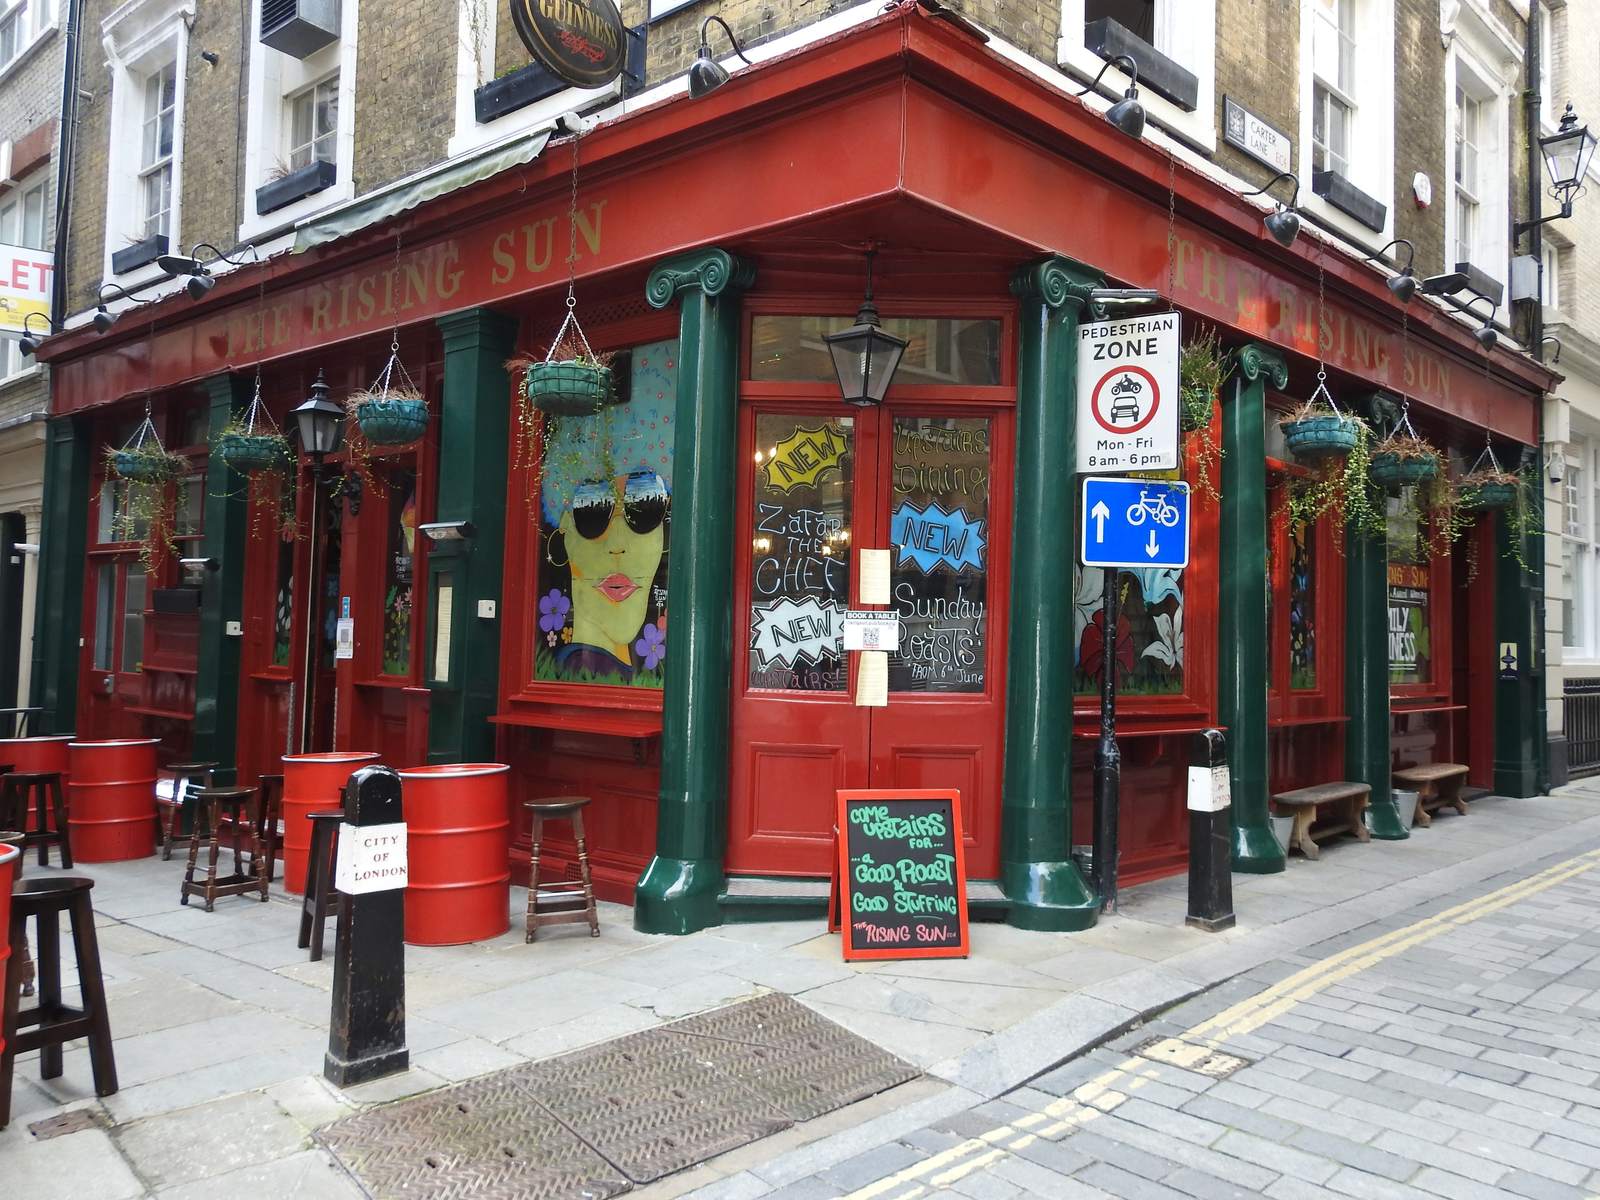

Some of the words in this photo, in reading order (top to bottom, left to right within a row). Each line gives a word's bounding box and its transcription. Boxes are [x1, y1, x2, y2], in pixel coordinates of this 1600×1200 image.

[538, 0, 617, 49] GUINNESS
[1251, 121, 1277, 145] CARTER
[1251, 136, 1268, 156] LANE
[0, 259, 57, 293] ET
[224, 303, 294, 358] THE
[310, 243, 466, 337] RISING
[491, 200, 608, 284] SUN
[1168, 232, 1258, 318] THE
[1278, 286, 1391, 370] RISING
[1404, 344, 1452, 397] SUN
[1081, 319, 1173, 339] PEDESTRIAN
[1093, 338, 1158, 361] ZONE
[1097, 440, 1124, 450] Mon
[1136, 437, 1153, 448] Fri
[775, 430, 836, 482] NEW
[1088, 456, 1096, 466] 8
[1099, 457, 1119, 466] am
[1129, 454, 1138, 464] 6
[893, 463, 987, 503] Dining
[787, 536, 823, 553] THE
[903, 517, 969, 560] NEW
[756, 556, 846, 595] CHEF
[895, 582, 983, 635] Sunday
[771, 610, 832, 647] NEW
[911, 663, 938, 679] FROM
[956, 668, 984, 685] June
[364, 835, 399, 848] CITY
[373, 852, 390, 862] OF
[354, 865, 407, 881] LONDON
[893, 879, 904, 891] &
